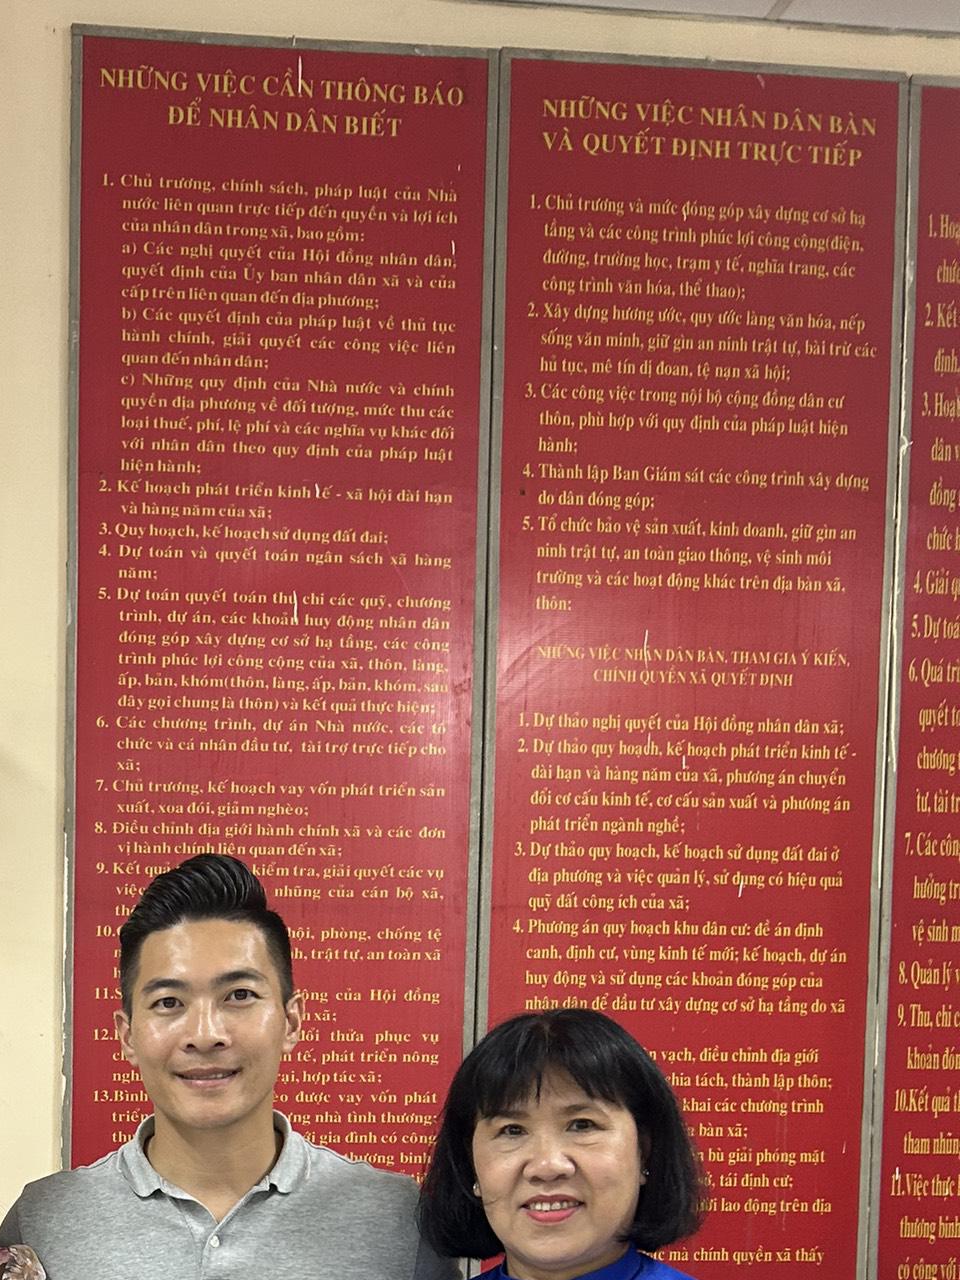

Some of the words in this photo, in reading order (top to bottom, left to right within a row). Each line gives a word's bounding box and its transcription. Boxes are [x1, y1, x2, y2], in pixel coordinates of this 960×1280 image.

[100, 65, 187, 91] NHỮNG
[196, 70, 255, 97] VIỆC
[262, 68, 313, 98] CẦN
[320, 79, 405, 104] THÔNG
[413, 83, 463, 106] BÁO
[168, 99, 201, 126] ĐỂ
[209, 106, 278, 130] NHÂN
[286, 111, 337, 133] DÂN
[345, 111, 402, 137] BIẾT
[543, 96, 627, 121] NHỮNG
[635, 100, 693, 127] VIỆC
[700, 105, 766, 129] NHÂN
[773, 109, 821, 131] DÂN
[829, 115, 876, 136] BÀN
[542, 130, 573, 151] VÀ
[582, 129, 666, 156] QUYẾT
[671, 137, 730, 160] ĐỊNH
[737, 140, 802, 166] TRỰC
[808, 141, 862, 167] TIẾP
[103, 173, 114, 186] 1.
[120, 173, 152, 187] Chủ
[159, 176, 215, 193] trương,
[221, 178, 263, 193] chính
[269, 180, 308, 196] sách,
[314, 183, 353, 200] pháp
[358, 185, 387, 202] luật
[394, 186, 420, 201] của
[427, 188, 457, 202] Nhà
[121, 242, 137, 254] a)
[143, 241, 173, 255] Các
[180, 243, 213, 259] nghị
[219, 246, 261, 261] quyết
[268, 246, 295, 260] của
[302, 248, 329, 264] Hội
[335, 250, 373, 267] đồng
[380, 252, 417, 266] nhân
[98, 522, 112, 535] 3.
[114, 522, 144, 539] Quy
[149, 523, 199, 539] hoạch,
[202, 525, 221, 538] kế
[224, 526, 269, 541] hoạch
[272, 526, 290, 540] sử
[292, 528, 330, 544] dụng
[332, 528, 356, 542] đất
[360, 530, 388, 544] đai;
[921, 658, 944, 688] Quá
[519, 712, 529, 727] 1.
[533, 712, 555, 730] Dự
[558, 711, 588, 728] thảo
[592, 714, 620, 732] nghị
[624, 712, 661, 733] quyết
[665, 713, 689, 731] của
[693, 715, 717, 734] Hội
[720, 717, 754, 735] đồng
[757, 717, 790, 733] nhân
[794, 718, 819, 734] dân
[823, 719, 844, 736] xã;
[94, 821, 107, 834] 8.
[112, 819, 148, 834] Điều
[152, 821, 193, 835] chỉnh
[198, 823, 220, 837] địa
[224, 823, 252, 838] giới
[256, 823, 294, 836] hành
[298, 824, 339, 837] chính
[343, 825, 360, 837] xã
[366, 825, 382, 838] và
[387, 825, 412, 838] các
[418, 826, 445, 839] đơn
[512, 918, 524, 933] 4.
[527, 918, 579, 938] Phương
[581, 918, 599, 934] án
[602, 923, 626, 938] quy
[630, 919, 670, 937] hoạch
[673, 920, 699, 935] khu
[702, 920, 727, 936] dân
[754, 919, 770, 936] đề
[774, 921, 791, 937] án
[794, 922, 823, 940] định
[912, 919, 924, 947] vệ
[898, 961, 908, 985] 8.
[911, 958, 940, 989] Quản
[942, 961, 952, 991] lý
[897, 1004, 906, 1028] 9.
[909, 1004, 933, 1032] Thu,
[936, 1004, 952, 1028] chi
[661, 1047, 696, 1064] vạch,
[699, 1044, 728, 1062] điều
[731, 1046, 767, 1062] chỉnh
[770, 1048, 790, 1065] địa
[794, 1048, 819, 1066] giới
[295, 1090, 331, 1105] được
[338, 1094, 361, 1106] vay
[370, 1089, 397, 1103] vốn
[404, 1091, 437, 1106] phát
[682, 1097, 711, 1112] khai
[714, 1097, 737, 1112] các
[740, 1098, 788, 1117] chương
[791, 1098, 824, 1113] trình
[932, 1086, 950, 1119] quả
[903, 1130, 930, 1155] tham
[668, 1246, 688, 1261] mà
[693, 1246, 729, 1261] chính
[732, 1244, 772, 1265] quyền
[775, 1247, 791, 1262] xã
[795, 1245, 824, 1265] thấy
[897, 1257, 910, 1280] có
